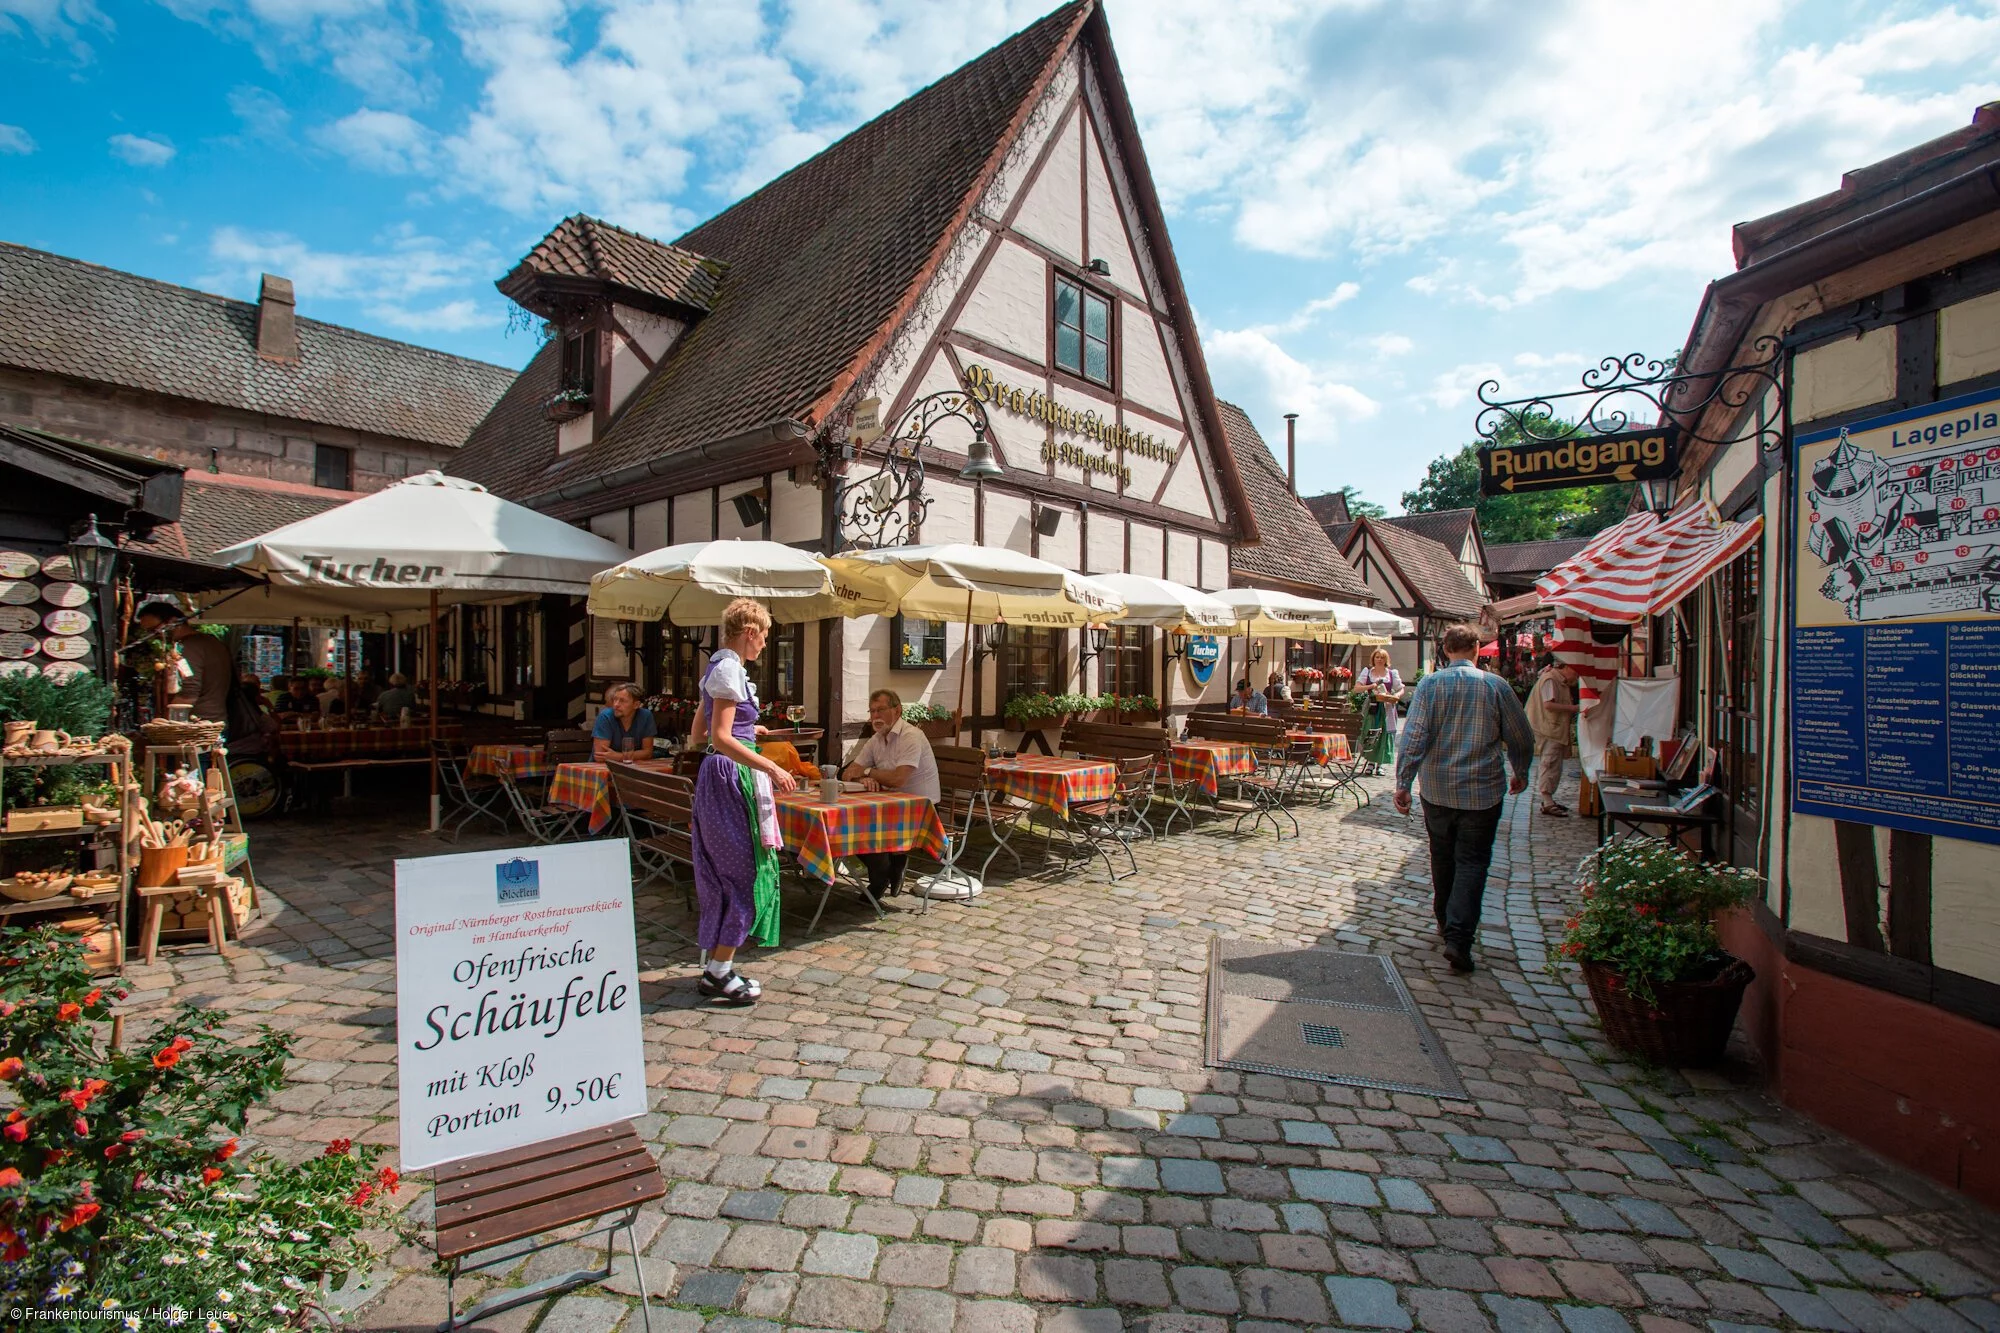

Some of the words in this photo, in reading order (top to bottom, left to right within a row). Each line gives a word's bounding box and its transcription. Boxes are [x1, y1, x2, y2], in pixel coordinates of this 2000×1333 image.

[1061, 442, 1131, 485] Nürnberg
[1490, 437, 1665, 477] Rundgang
[303, 555, 444, 582] Tucher
[1192, 644, 1217, 656] Tucher
[409, 919, 457, 937] Original
[458, 912, 520, 930] Nürnberger
[522, 899, 623, 922] Rostbratwurstküche
[472, 934, 485, 945] im
[488, 921, 572, 942] Handwerkerhof
[453, 939, 596, 990] Ofenfrische
[414, 970, 627, 1051] Schäufele
[427, 1070, 468, 1098] mit
[476, 1052, 536, 1088] Kloß
[427, 1102, 521, 1138] Portion
[545, 1072, 622, 1114] 9,50€
